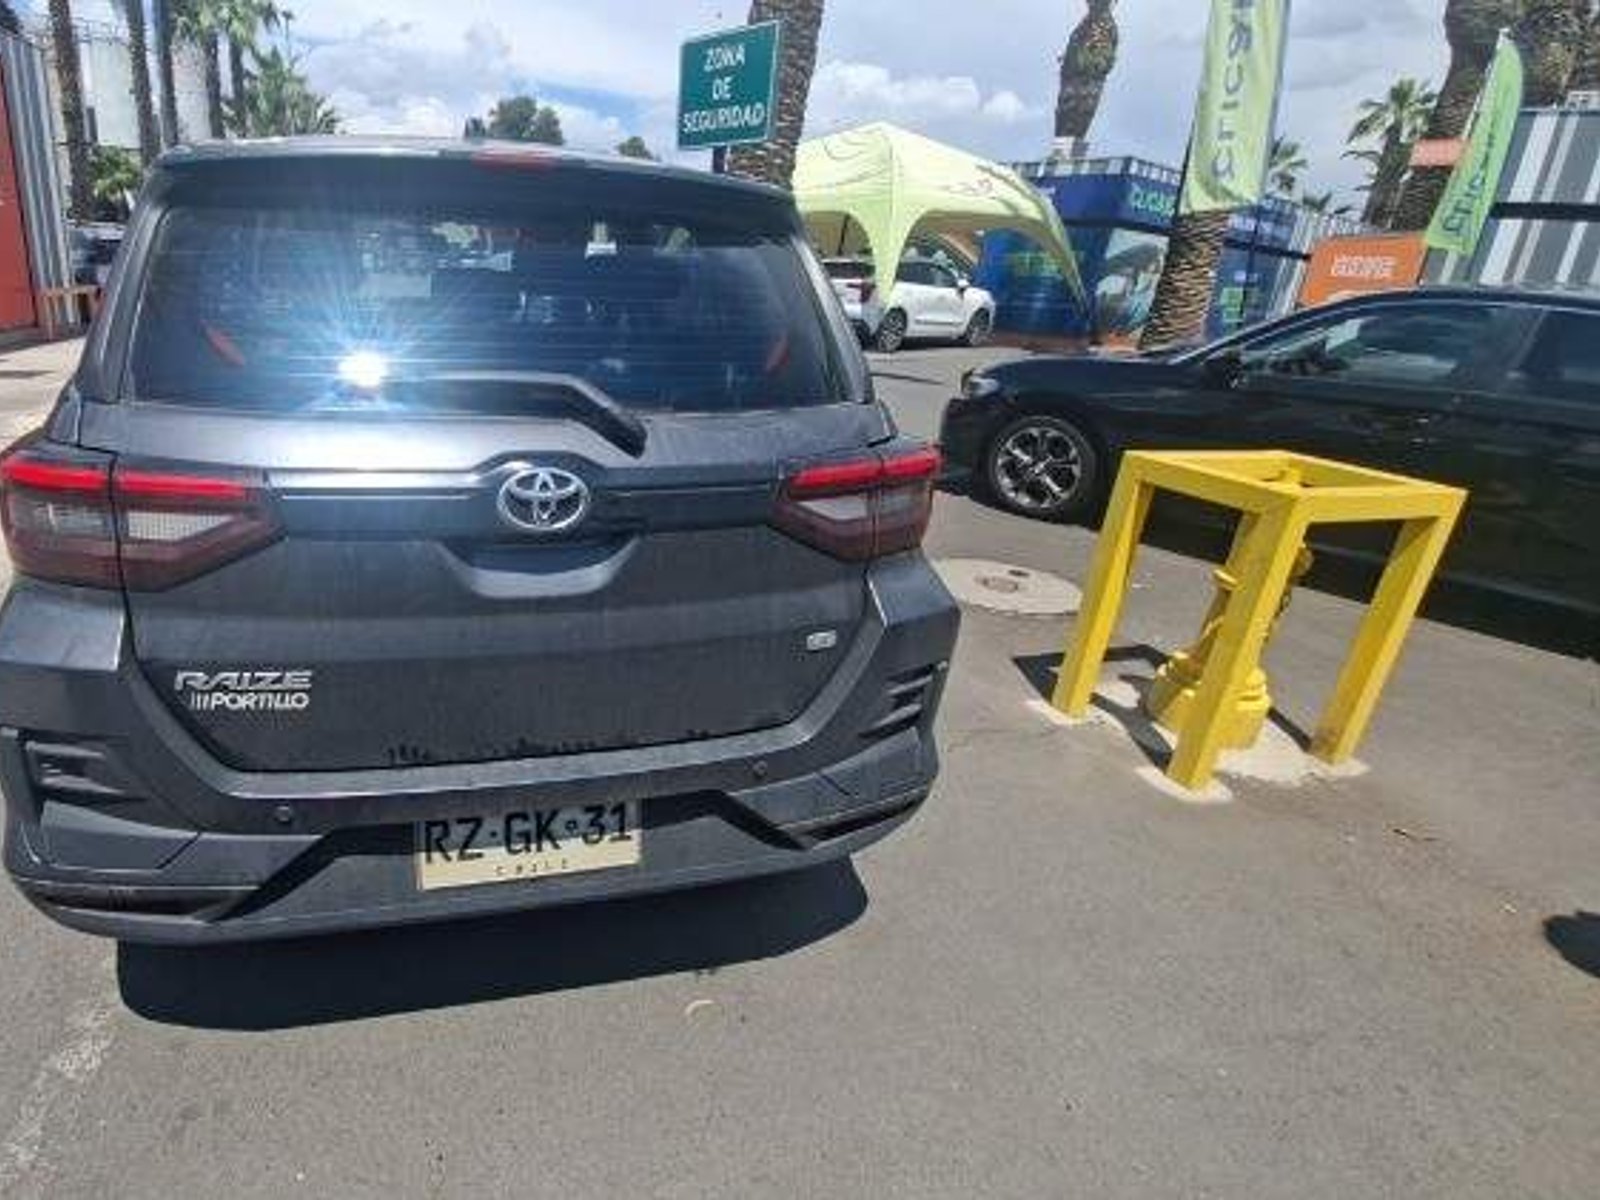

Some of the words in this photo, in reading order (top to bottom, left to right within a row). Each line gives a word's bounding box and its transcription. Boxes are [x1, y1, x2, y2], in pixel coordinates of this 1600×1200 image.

[703, 44, 746, 72] ZONA
[712, 76, 732, 100] DE
[683, 102, 765, 133] SEGURIDAD
[174, 671, 312, 690] RAIZE
[210, 692, 310, 711] PORTILLO
